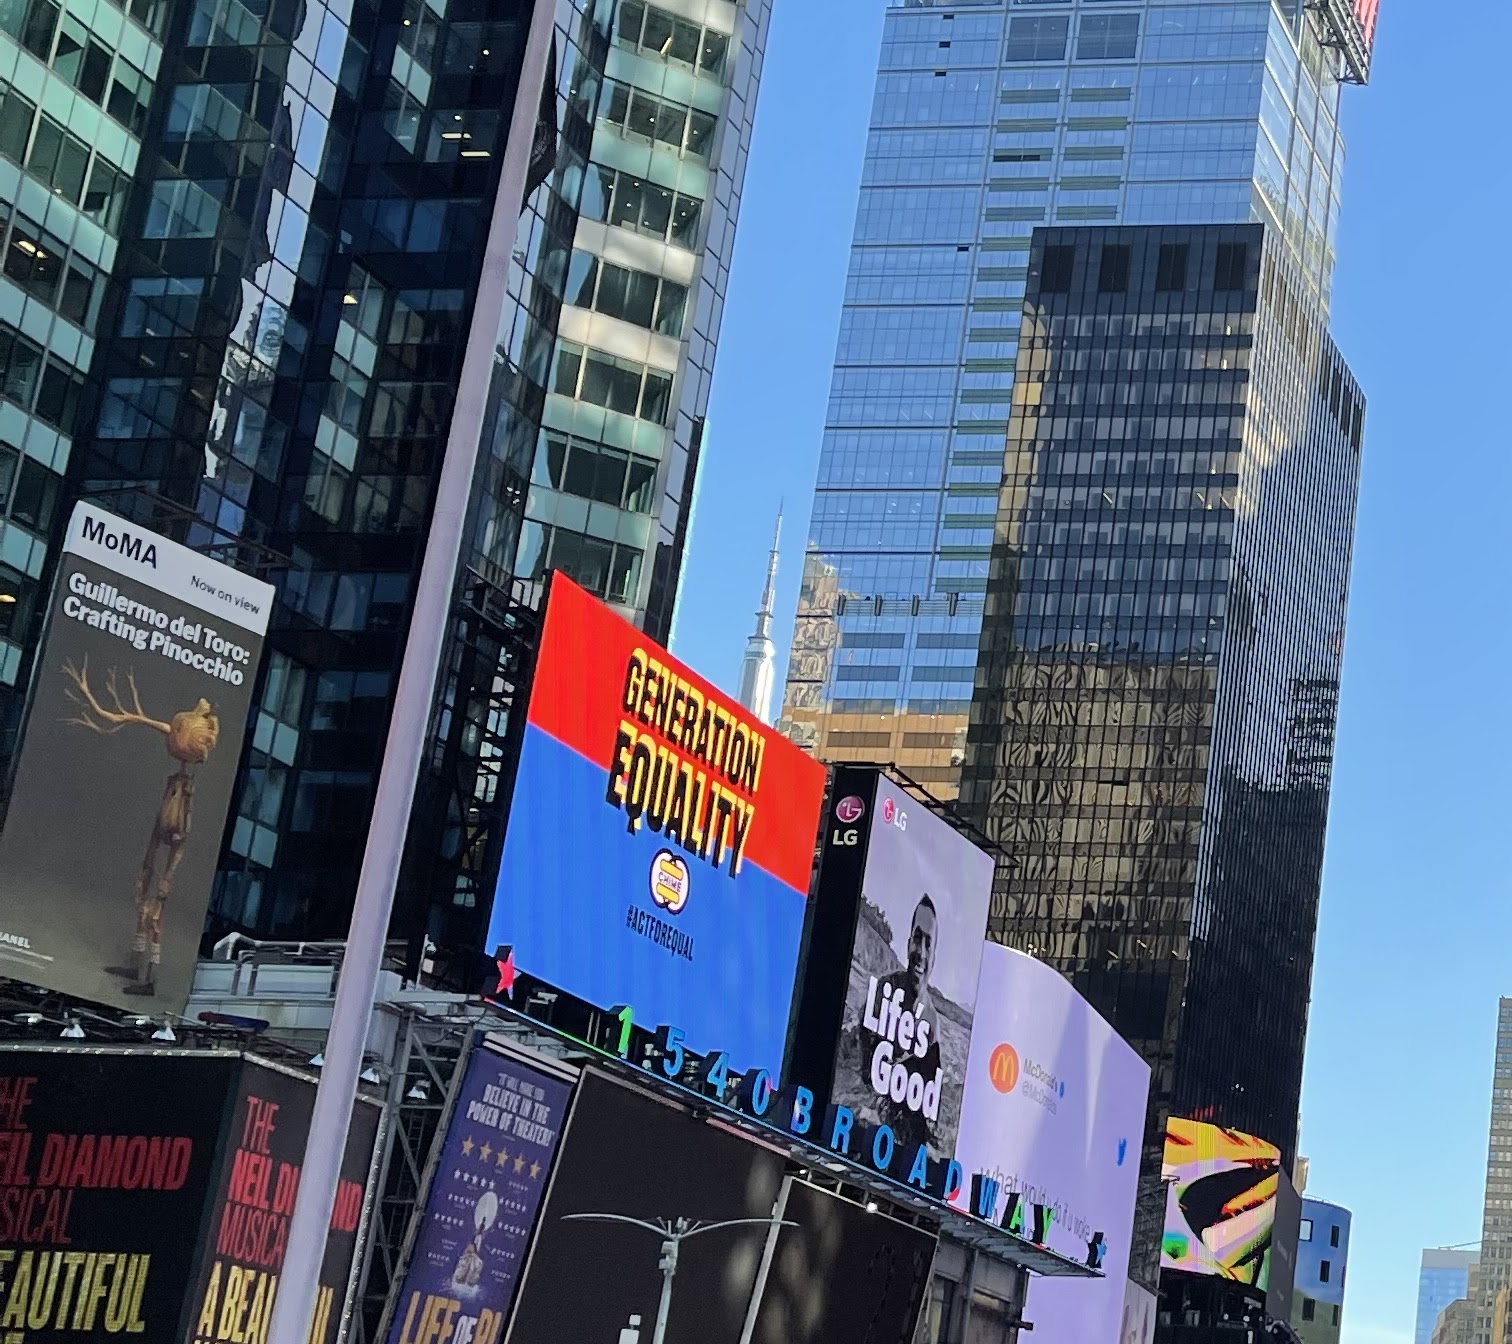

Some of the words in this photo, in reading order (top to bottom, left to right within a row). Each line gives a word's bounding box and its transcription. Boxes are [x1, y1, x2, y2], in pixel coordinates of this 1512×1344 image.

[81, 515, 158, 570] MoMA
[68, 572, 169, 630] Guillermo
[169, 616, 202, 644] del
[202, 627, 251, 666] Toro:
[190, 575, 215, 596] Now
[217, 589, 233, 604] on
[234, 595, 261, 615] view
[63, 595, 149, 651] Crafting
[149, 631, 244, 686] Pinocchio
[621, 647, 766, 797] GENERATION
[605, 720, 755, 880] EQUALITY
[893, 806, 908, 832] LG
[832, 829, 858, 846] LG
[625, 904, 693, 962] #ACTFOREQUAL
[863, 976, 931, 1058] Life's
[871, 1040, 944, 1122] Good
[246, 1095, 279, 1155] THE
[37, 1134, 193, 1191] DIAMOND
[227, 1148, 273, 1211] NEIL
[785, 1084, 1056, 1246] BROADWAY
[215, 1201, 289, 1269] MUSICA
[0, 1250, 152, 1333] EAUTIFUL
[196, 1260, 222, 1338] A
